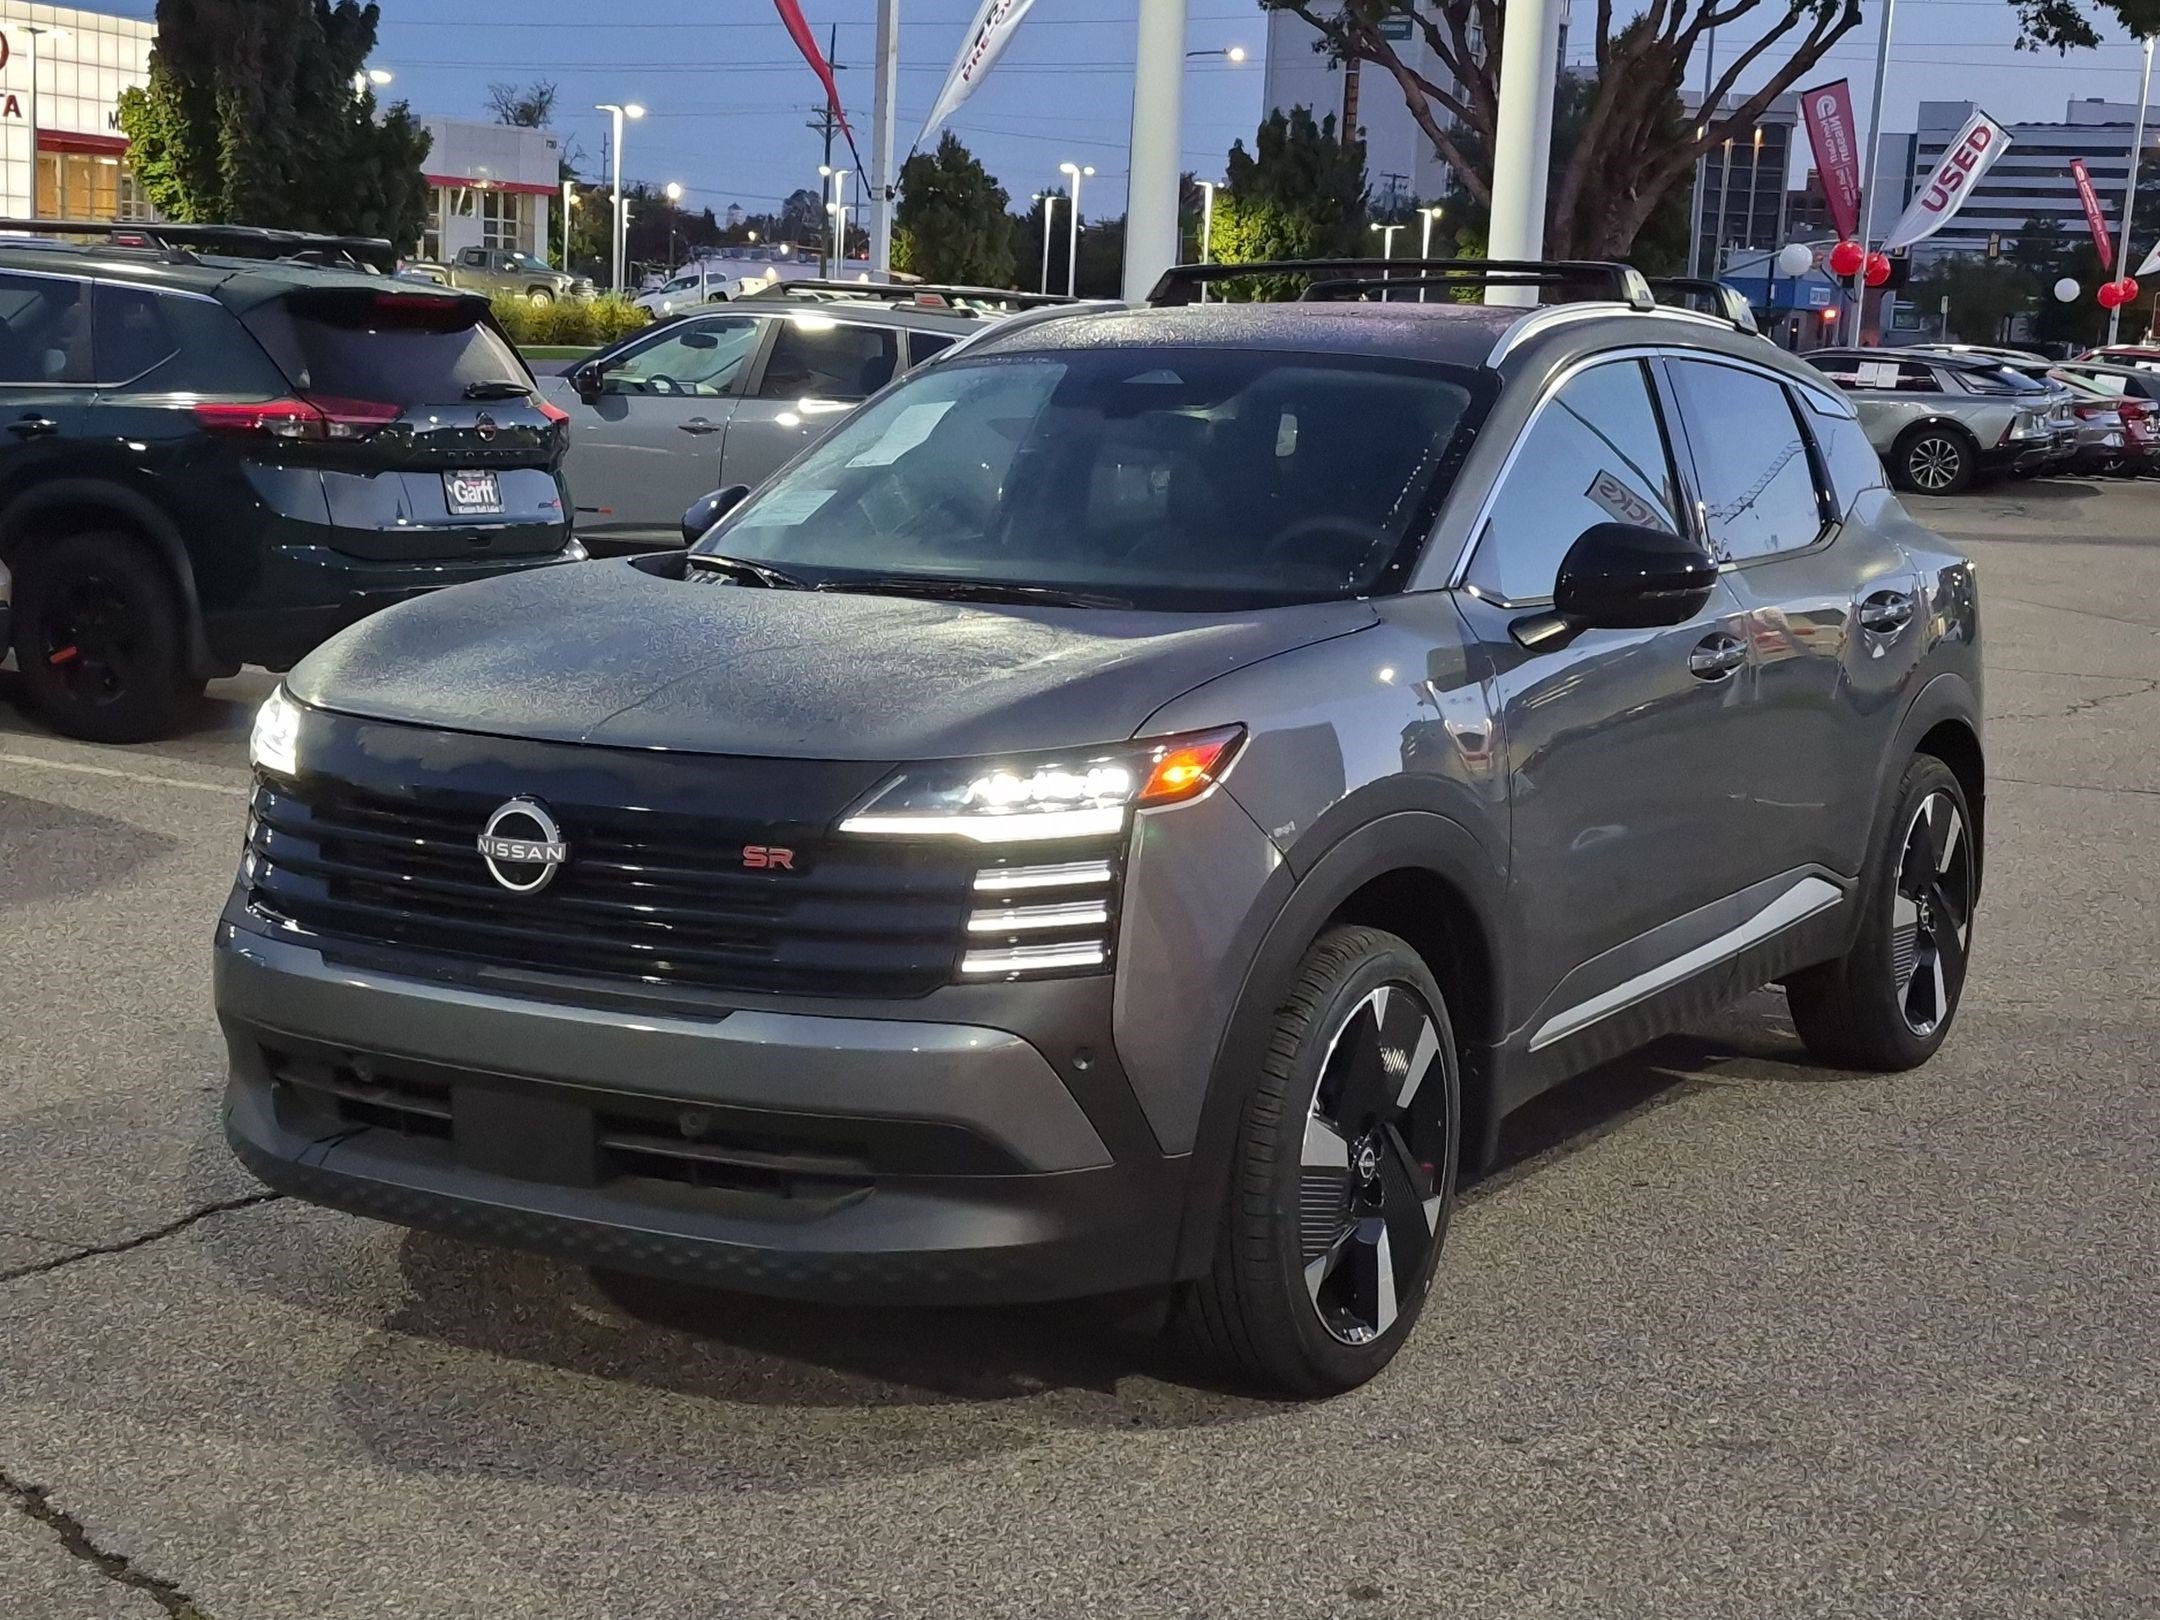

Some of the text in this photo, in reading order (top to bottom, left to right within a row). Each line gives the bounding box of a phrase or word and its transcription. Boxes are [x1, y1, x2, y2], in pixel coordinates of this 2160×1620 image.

[1921, 126, 1992, 212] USED
[478, 838, 563, 861] NISSAN
[742, 845, 794, 870] SR
